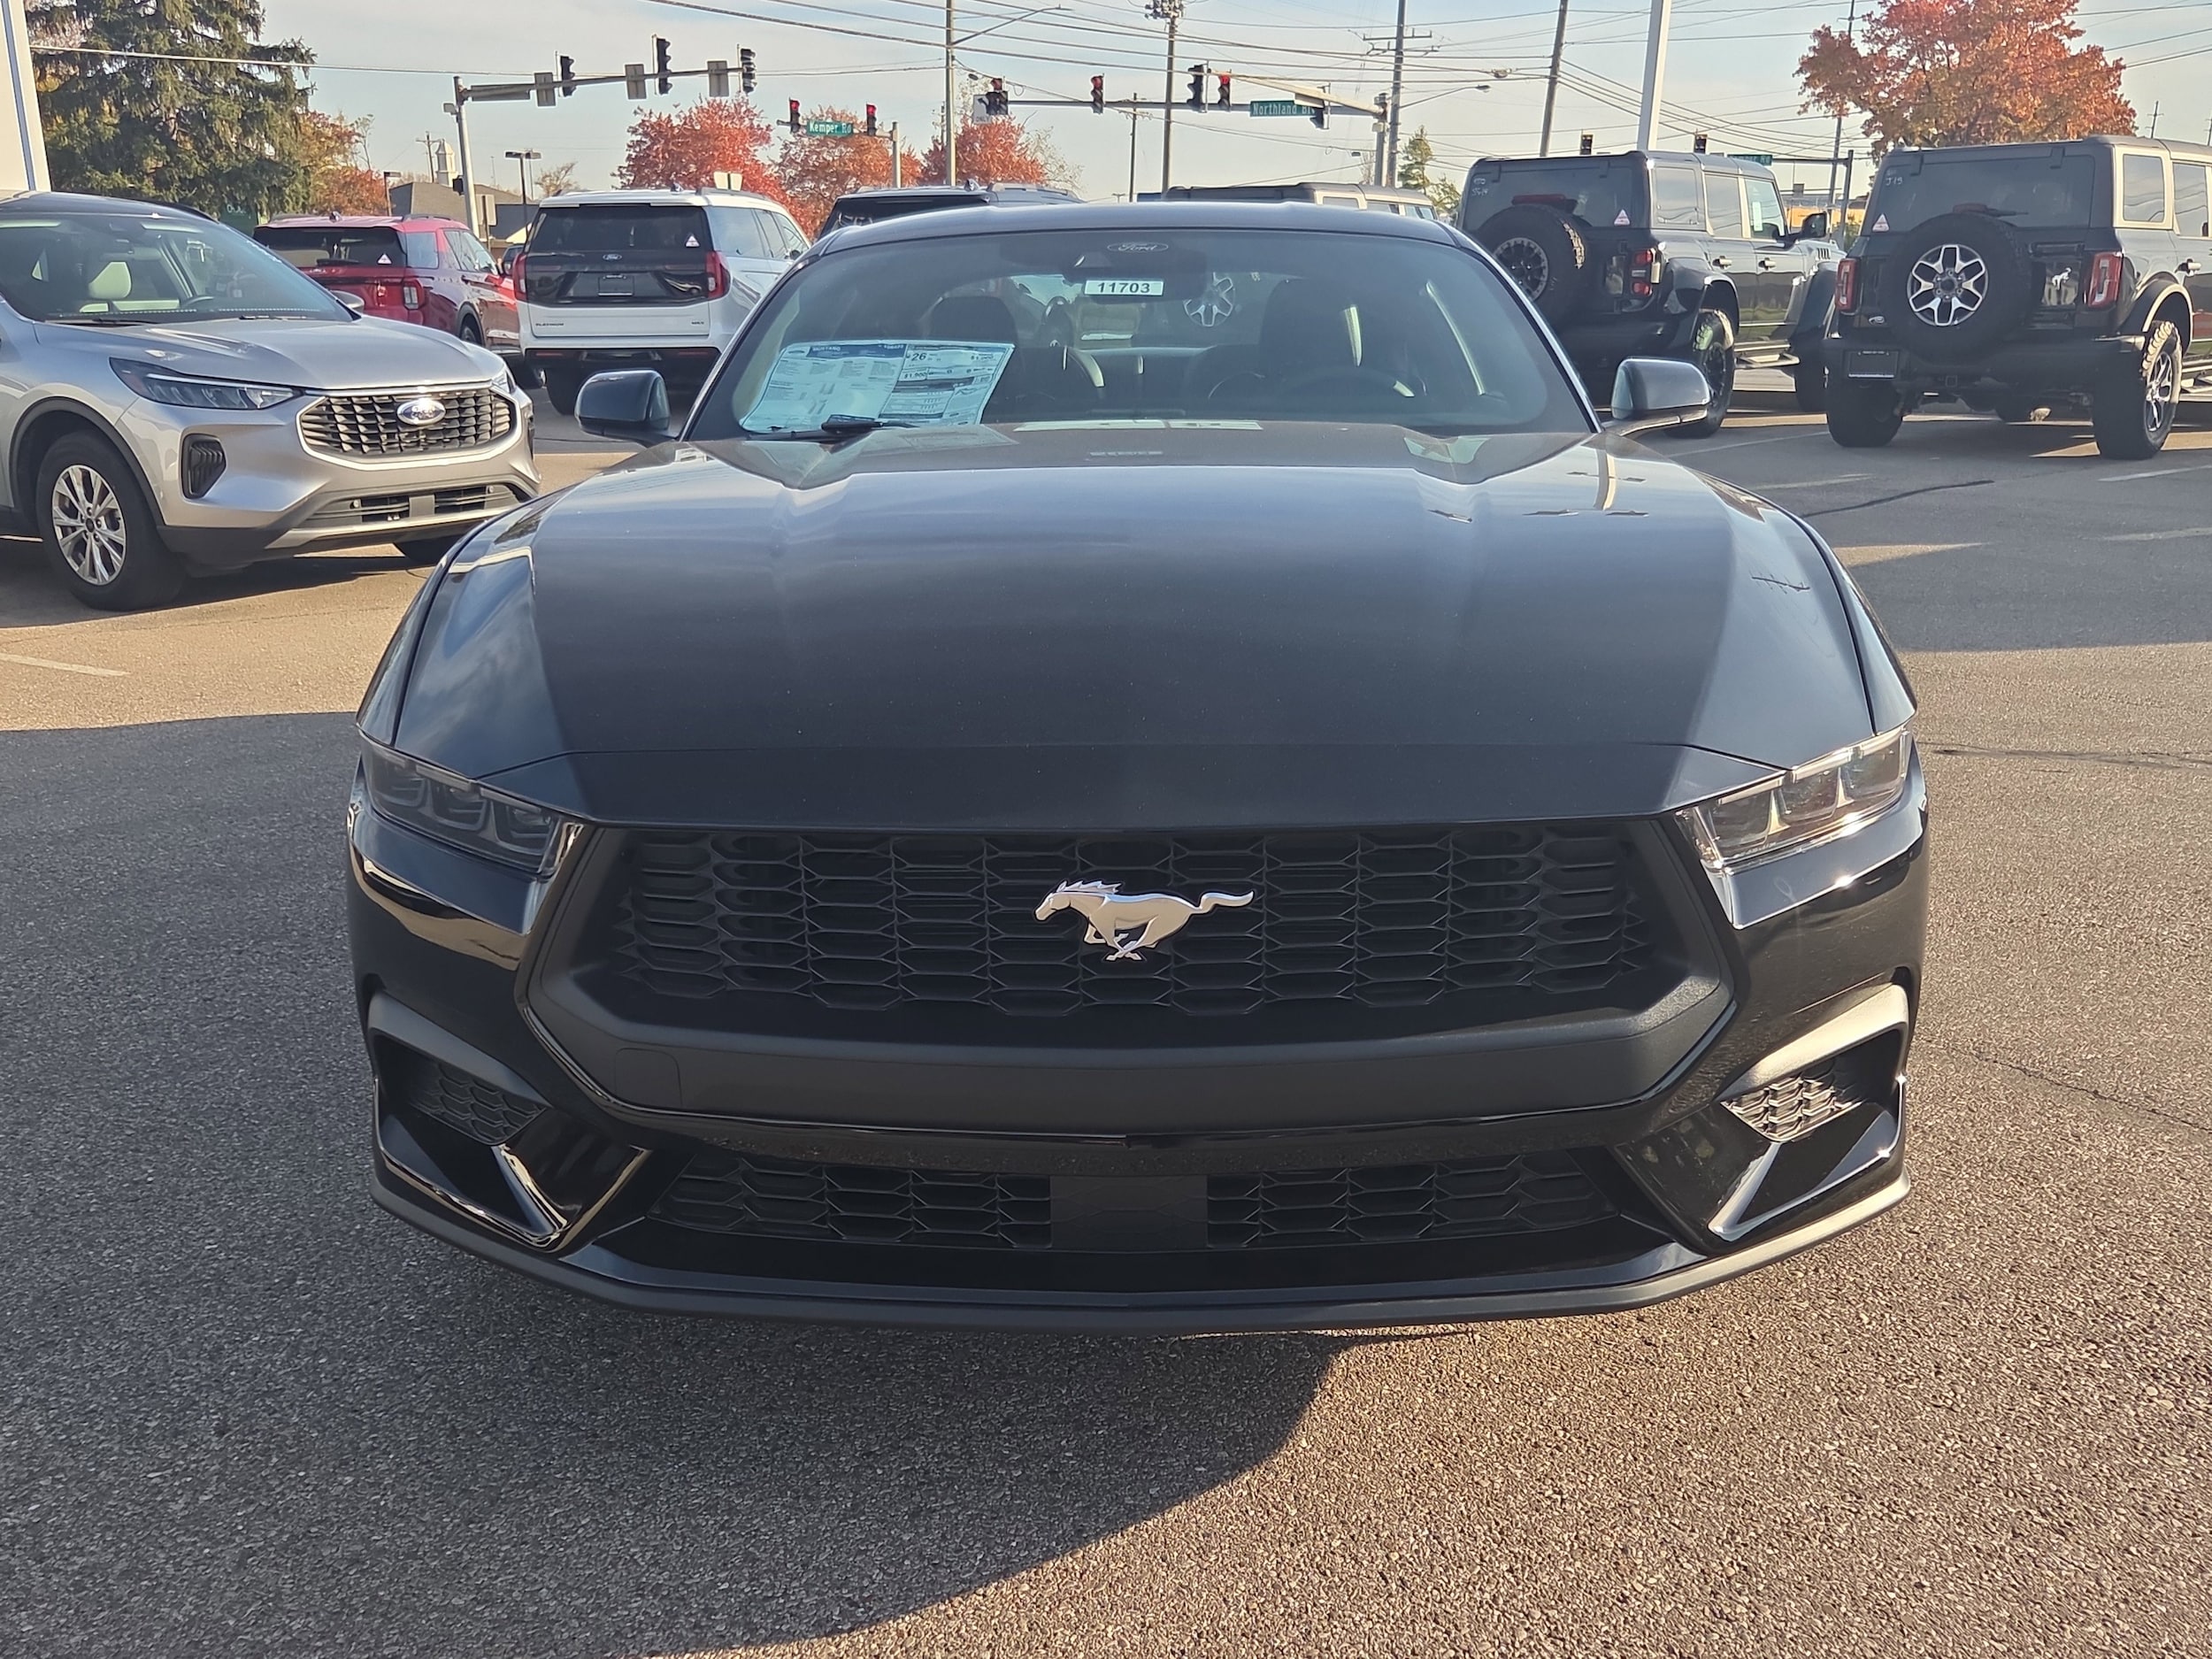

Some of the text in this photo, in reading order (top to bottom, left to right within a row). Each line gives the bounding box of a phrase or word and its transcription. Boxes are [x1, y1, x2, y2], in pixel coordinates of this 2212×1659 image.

[1253, 103, 1298, 115] Northland
[809, 120, 852, 134] Kemper Rd
[1097, 282, 1150, 294] 11703
[911, 352, 927, 361] 26
